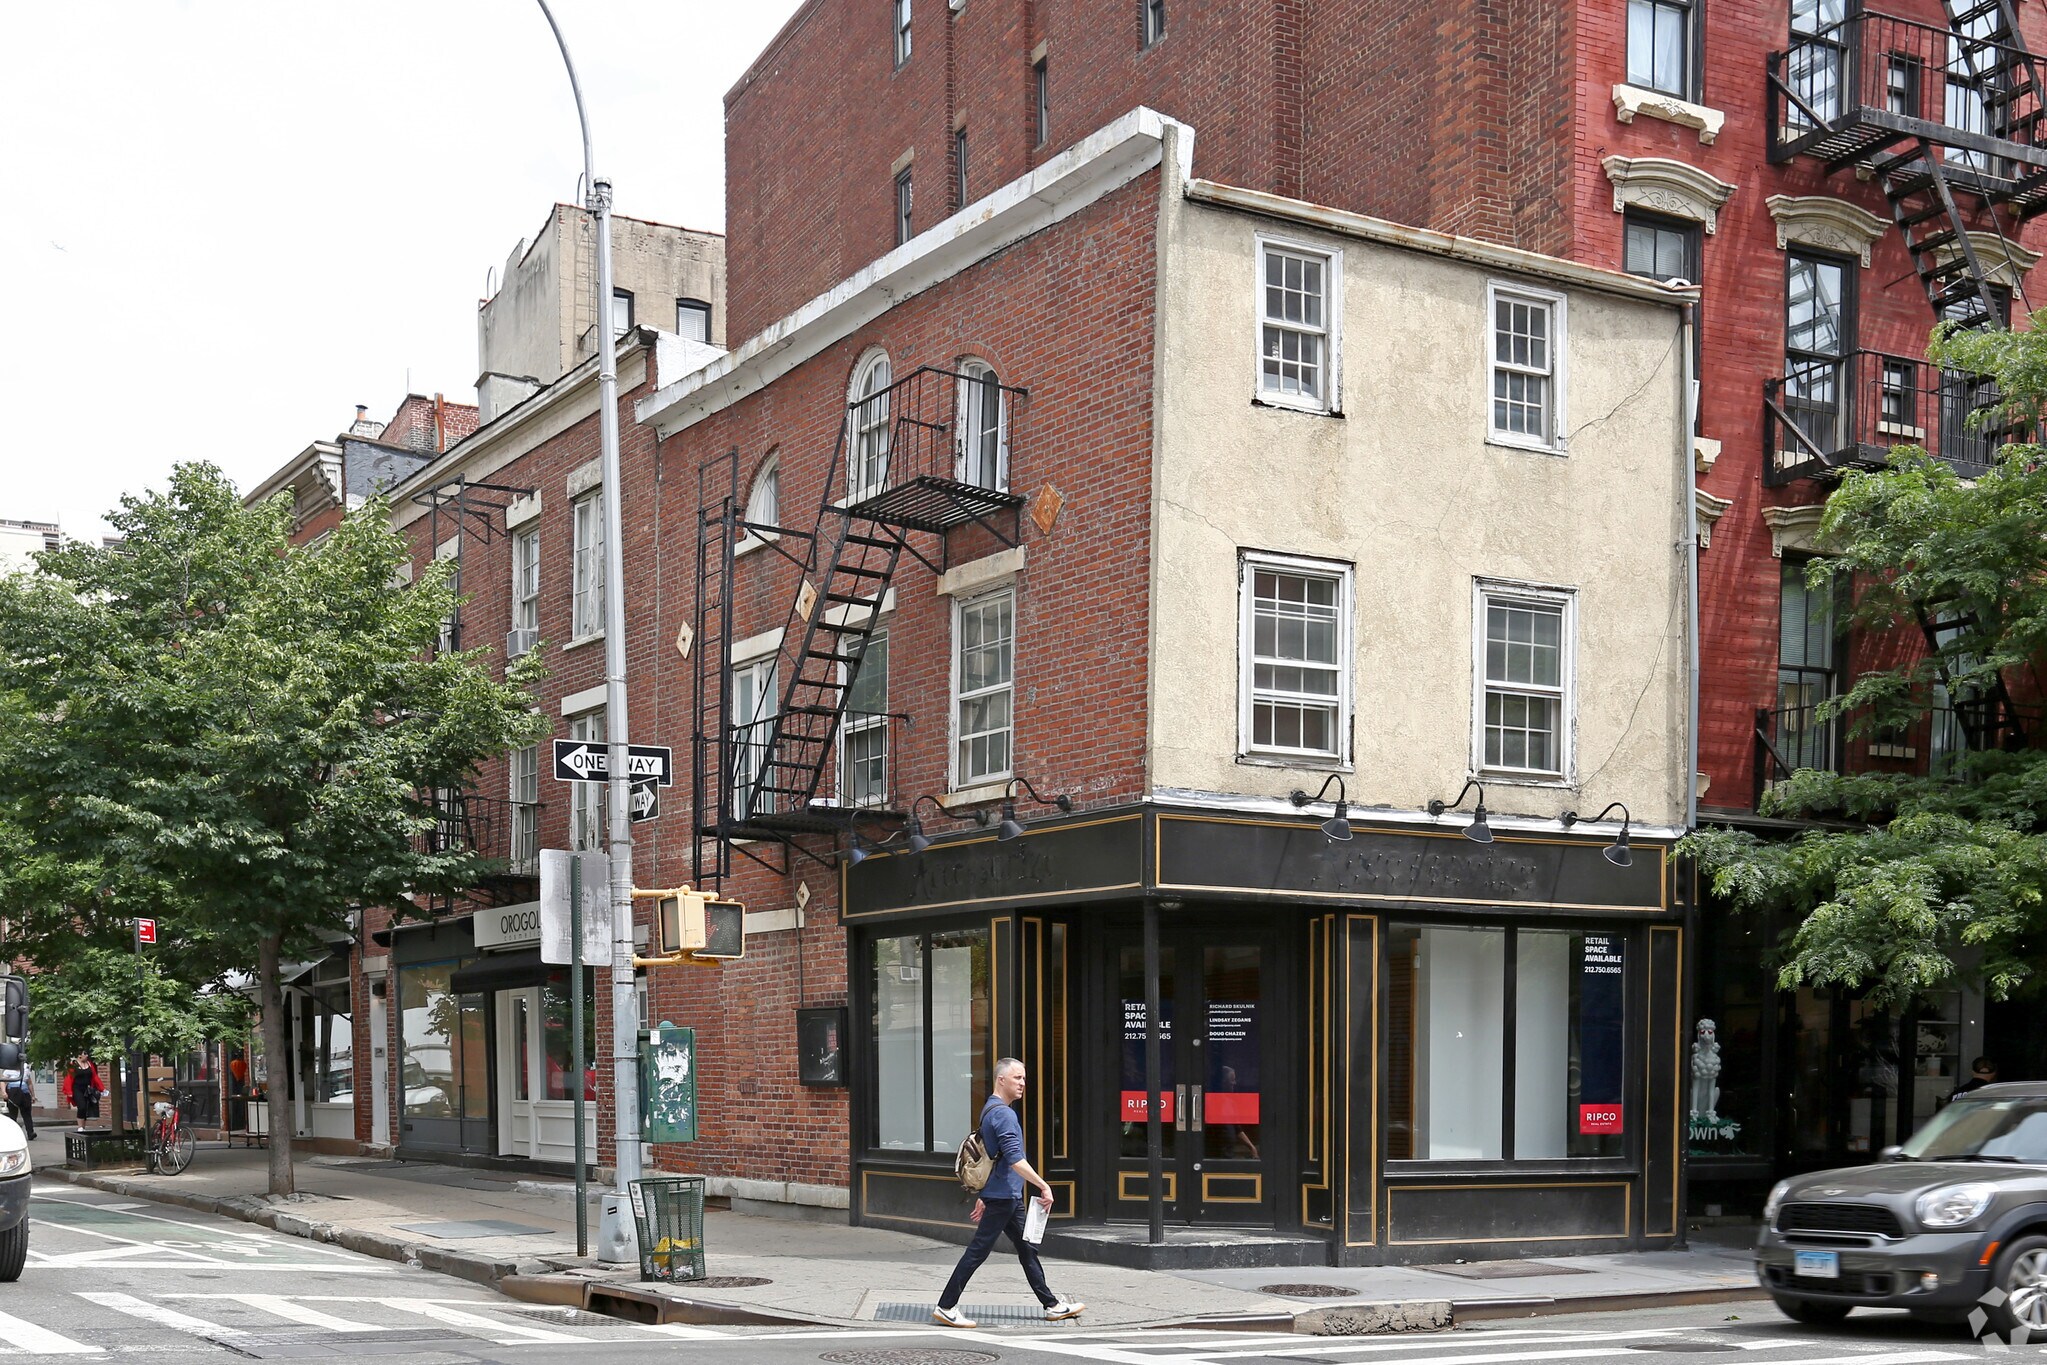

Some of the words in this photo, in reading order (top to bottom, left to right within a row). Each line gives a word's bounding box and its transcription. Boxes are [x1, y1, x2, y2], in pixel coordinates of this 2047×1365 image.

[573, 754, 606, 770] ONE
[634, 793, 650, 810] WAY
[500, 910, 541, 934] OROGOL
[1585, 937, 1609, 945] RETAIL
[1125, 1003, 1146, 1011] RETA
[1127, 1099, 1167, 1109] RIPO
[1586, 1112, 1616, 1121] RIPCO
